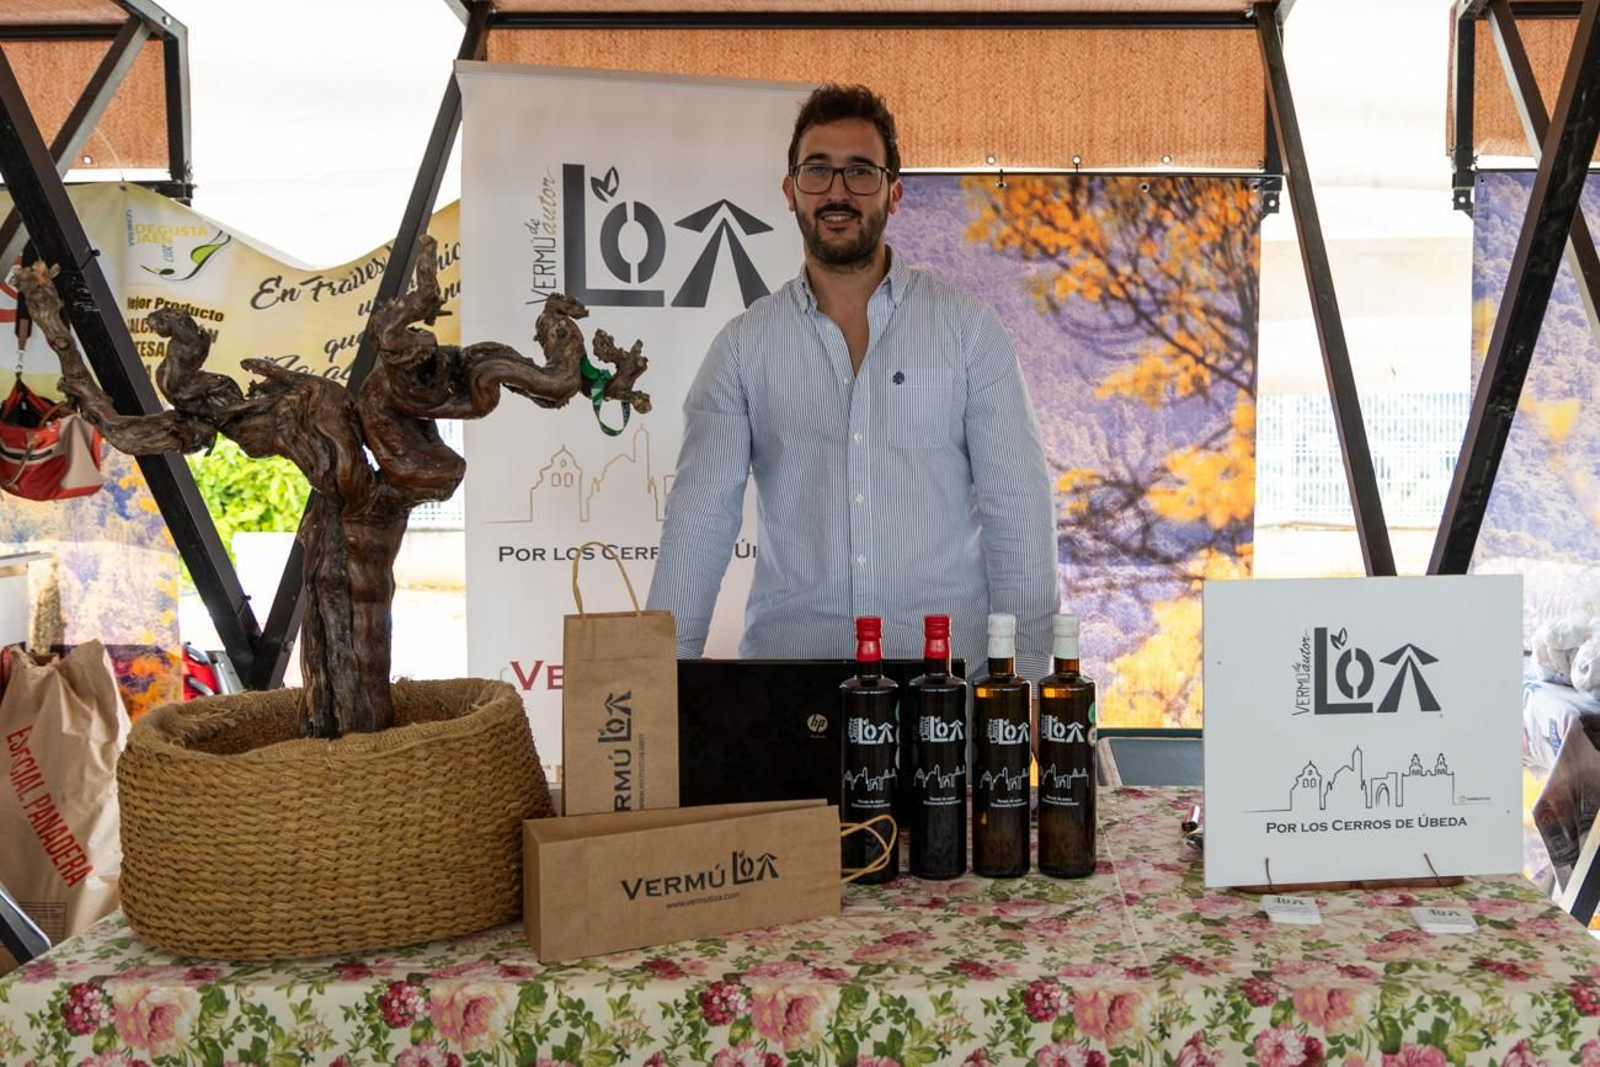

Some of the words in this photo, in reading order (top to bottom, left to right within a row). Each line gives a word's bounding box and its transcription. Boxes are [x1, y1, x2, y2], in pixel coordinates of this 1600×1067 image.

[250, 275, 300, 310] En
[509, 660, 564, 690] VE
[807, 713, 828, 732] hp
[606, 748, 632, 812] RMÚ
[23, 792, 94, 888] PANADERA
[620, 863, 726, 902] VERMÚ
